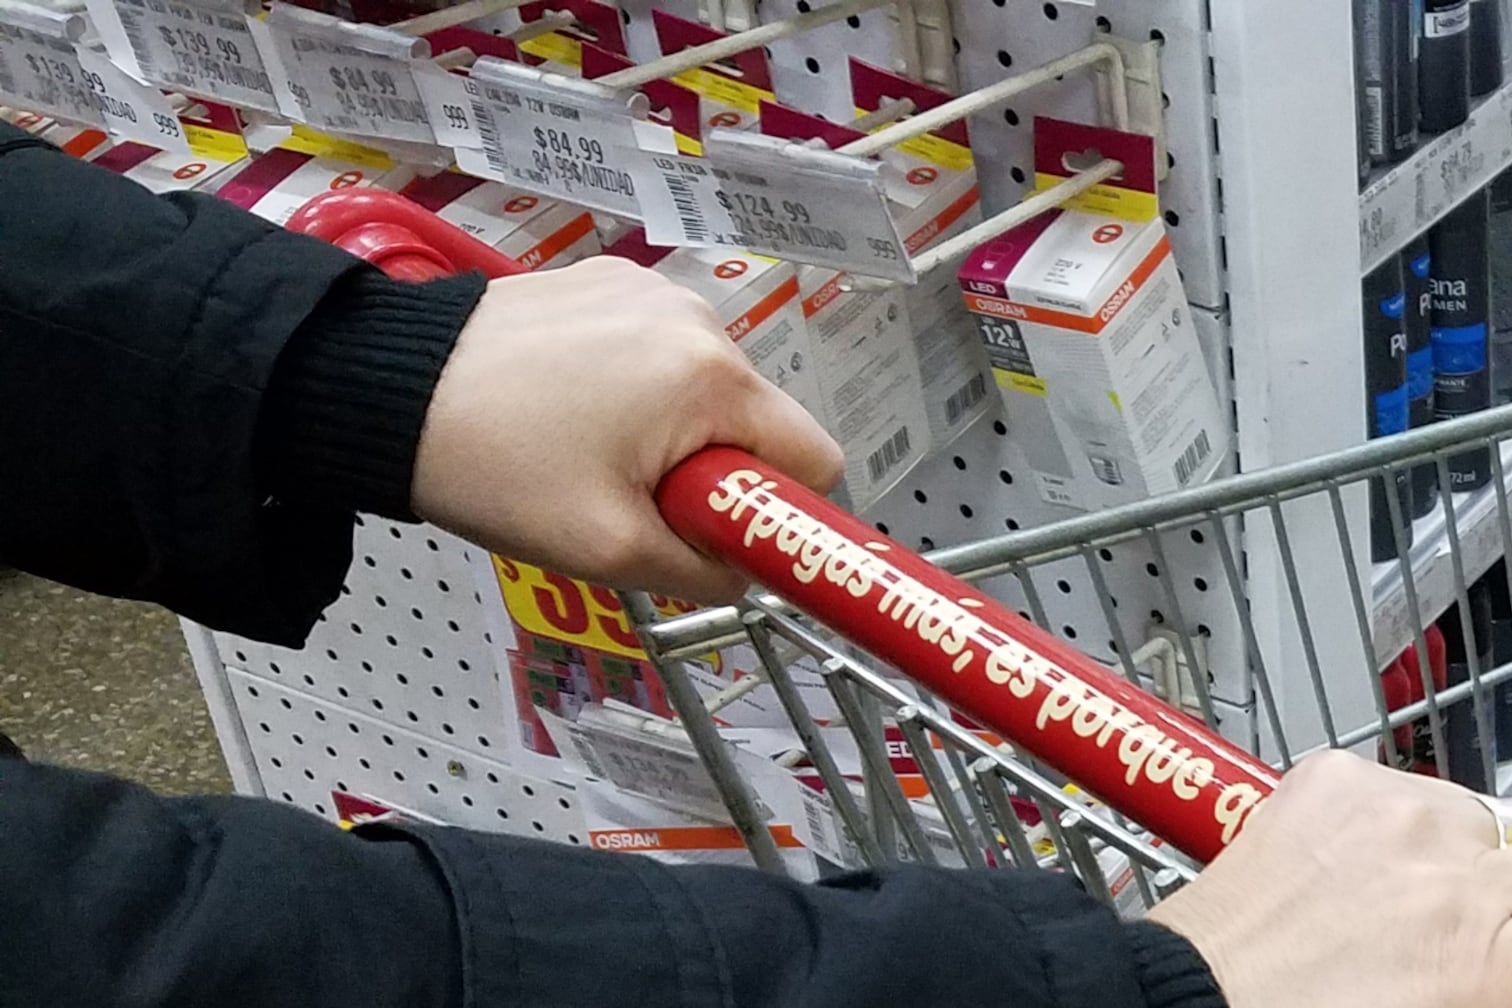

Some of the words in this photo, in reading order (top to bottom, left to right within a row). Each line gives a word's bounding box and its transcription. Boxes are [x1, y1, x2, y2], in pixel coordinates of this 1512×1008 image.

[152, 112, 180, 138] 999
[533, 126, 603, 164] $84.99
[969, 280, 998, 295] LED
[975, 298, 1029, 319] OSRAM
[743, 494, 892, 599] pagás
[877, 577, 985, 674] más,
[984, 648, 1037, 698] es
[1035, 676, 1215, 801] porque
[595, 831, 660, 849] OSRAM
